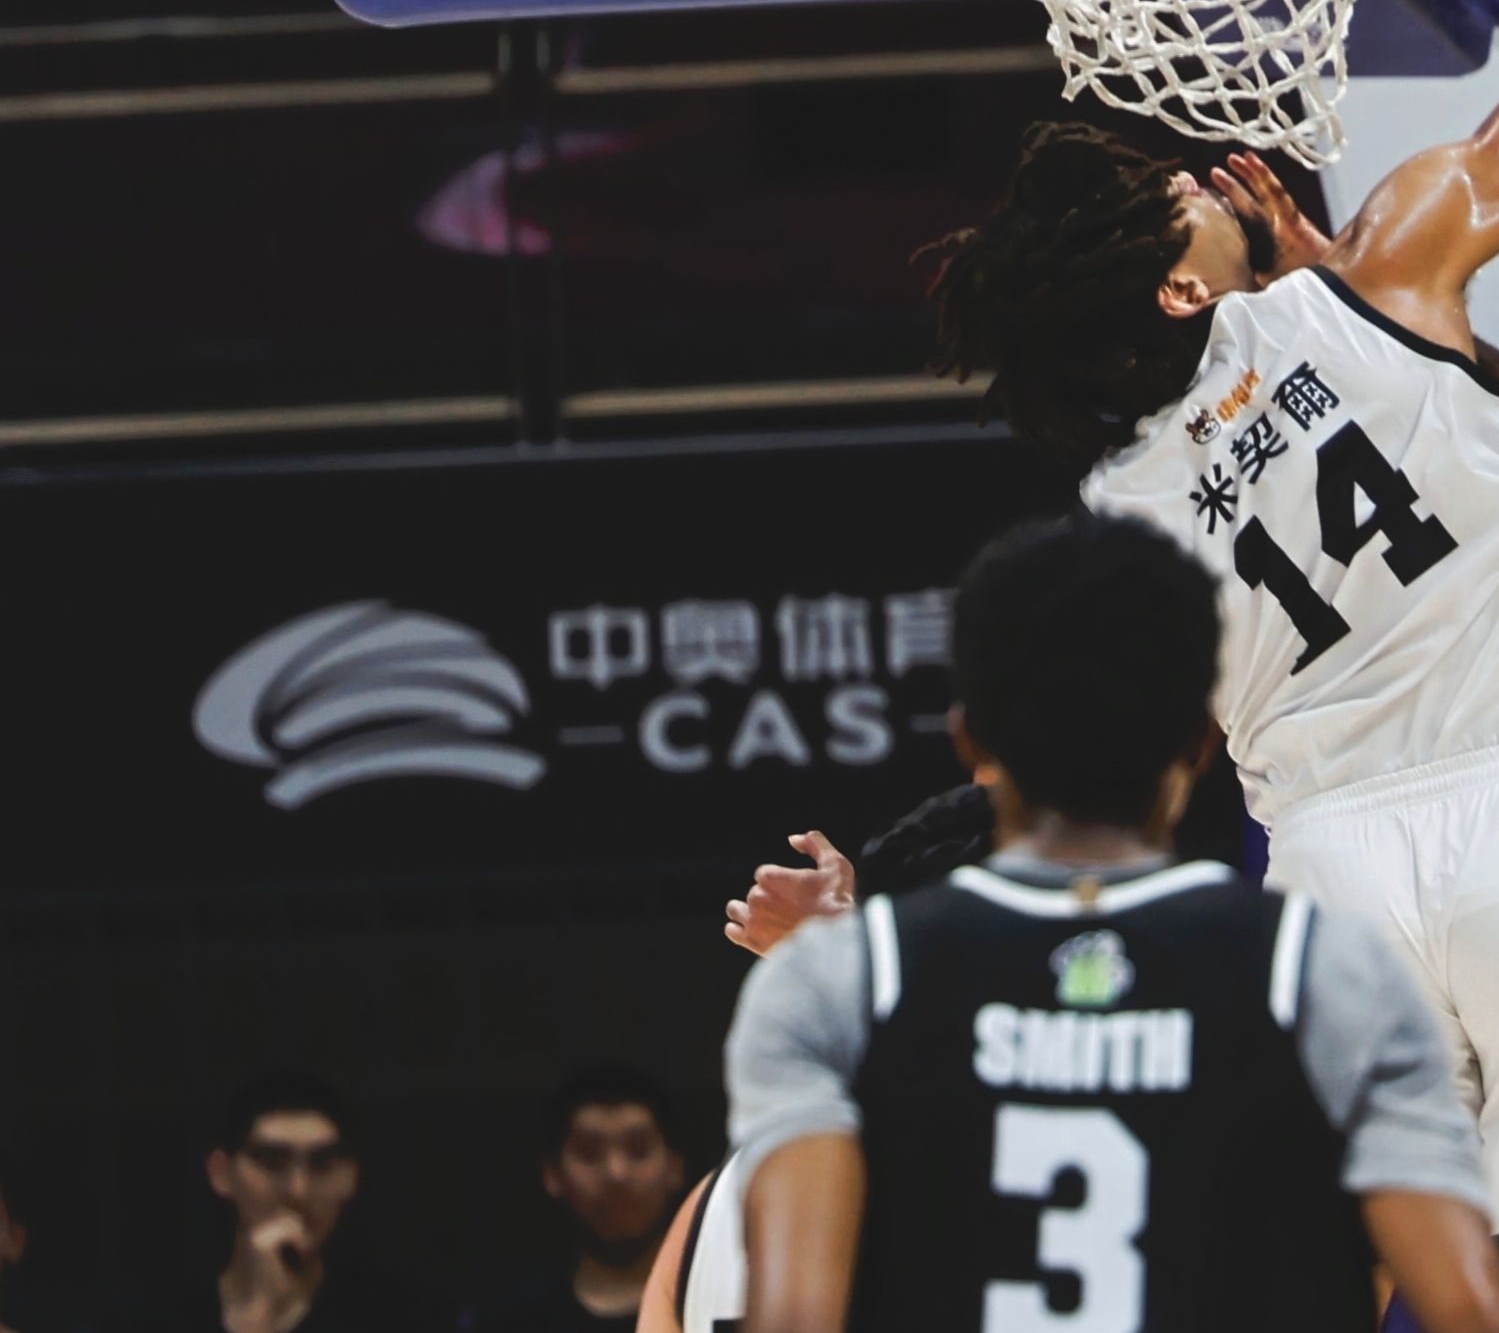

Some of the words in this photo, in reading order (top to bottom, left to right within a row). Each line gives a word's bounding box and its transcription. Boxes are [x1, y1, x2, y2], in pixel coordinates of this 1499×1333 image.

[1189, 361, 1340, 535] 米契爾
[1233, 418, 1459, 676] 14
[639, 683, 894, 771] CAS
[974, 1002, 1193, 1093] SMITH
